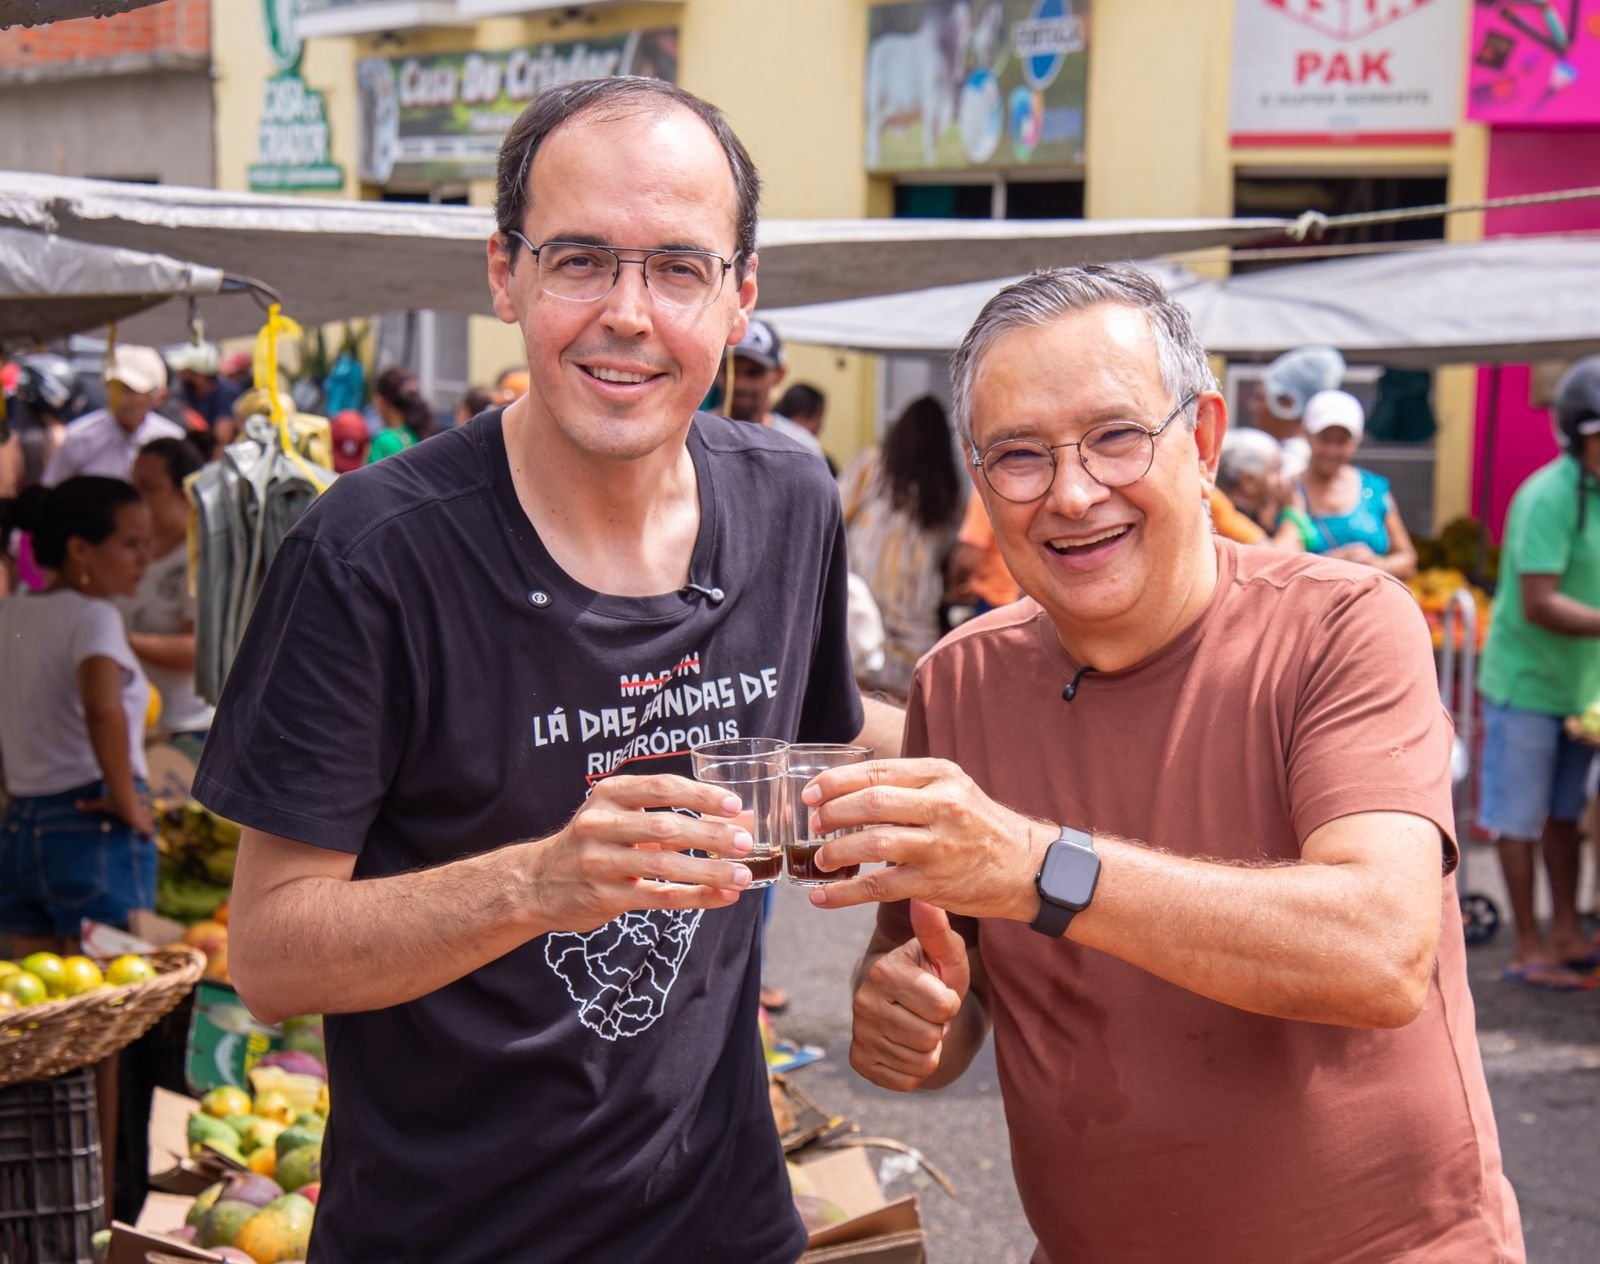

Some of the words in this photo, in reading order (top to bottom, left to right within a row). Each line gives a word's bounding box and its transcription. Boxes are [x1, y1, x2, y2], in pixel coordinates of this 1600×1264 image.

[400, 59, 457, 107] Casa
[461, 53, 501, 103] Do
[1295, 51, 1392, 85] PAK
[533, 706, 569, 747] LÁ
[579, 707, 637, 743] DAS
[740, 667, 778, 705] DE
[587, 719, 740, 776] RIBEIRÓPOLIS
